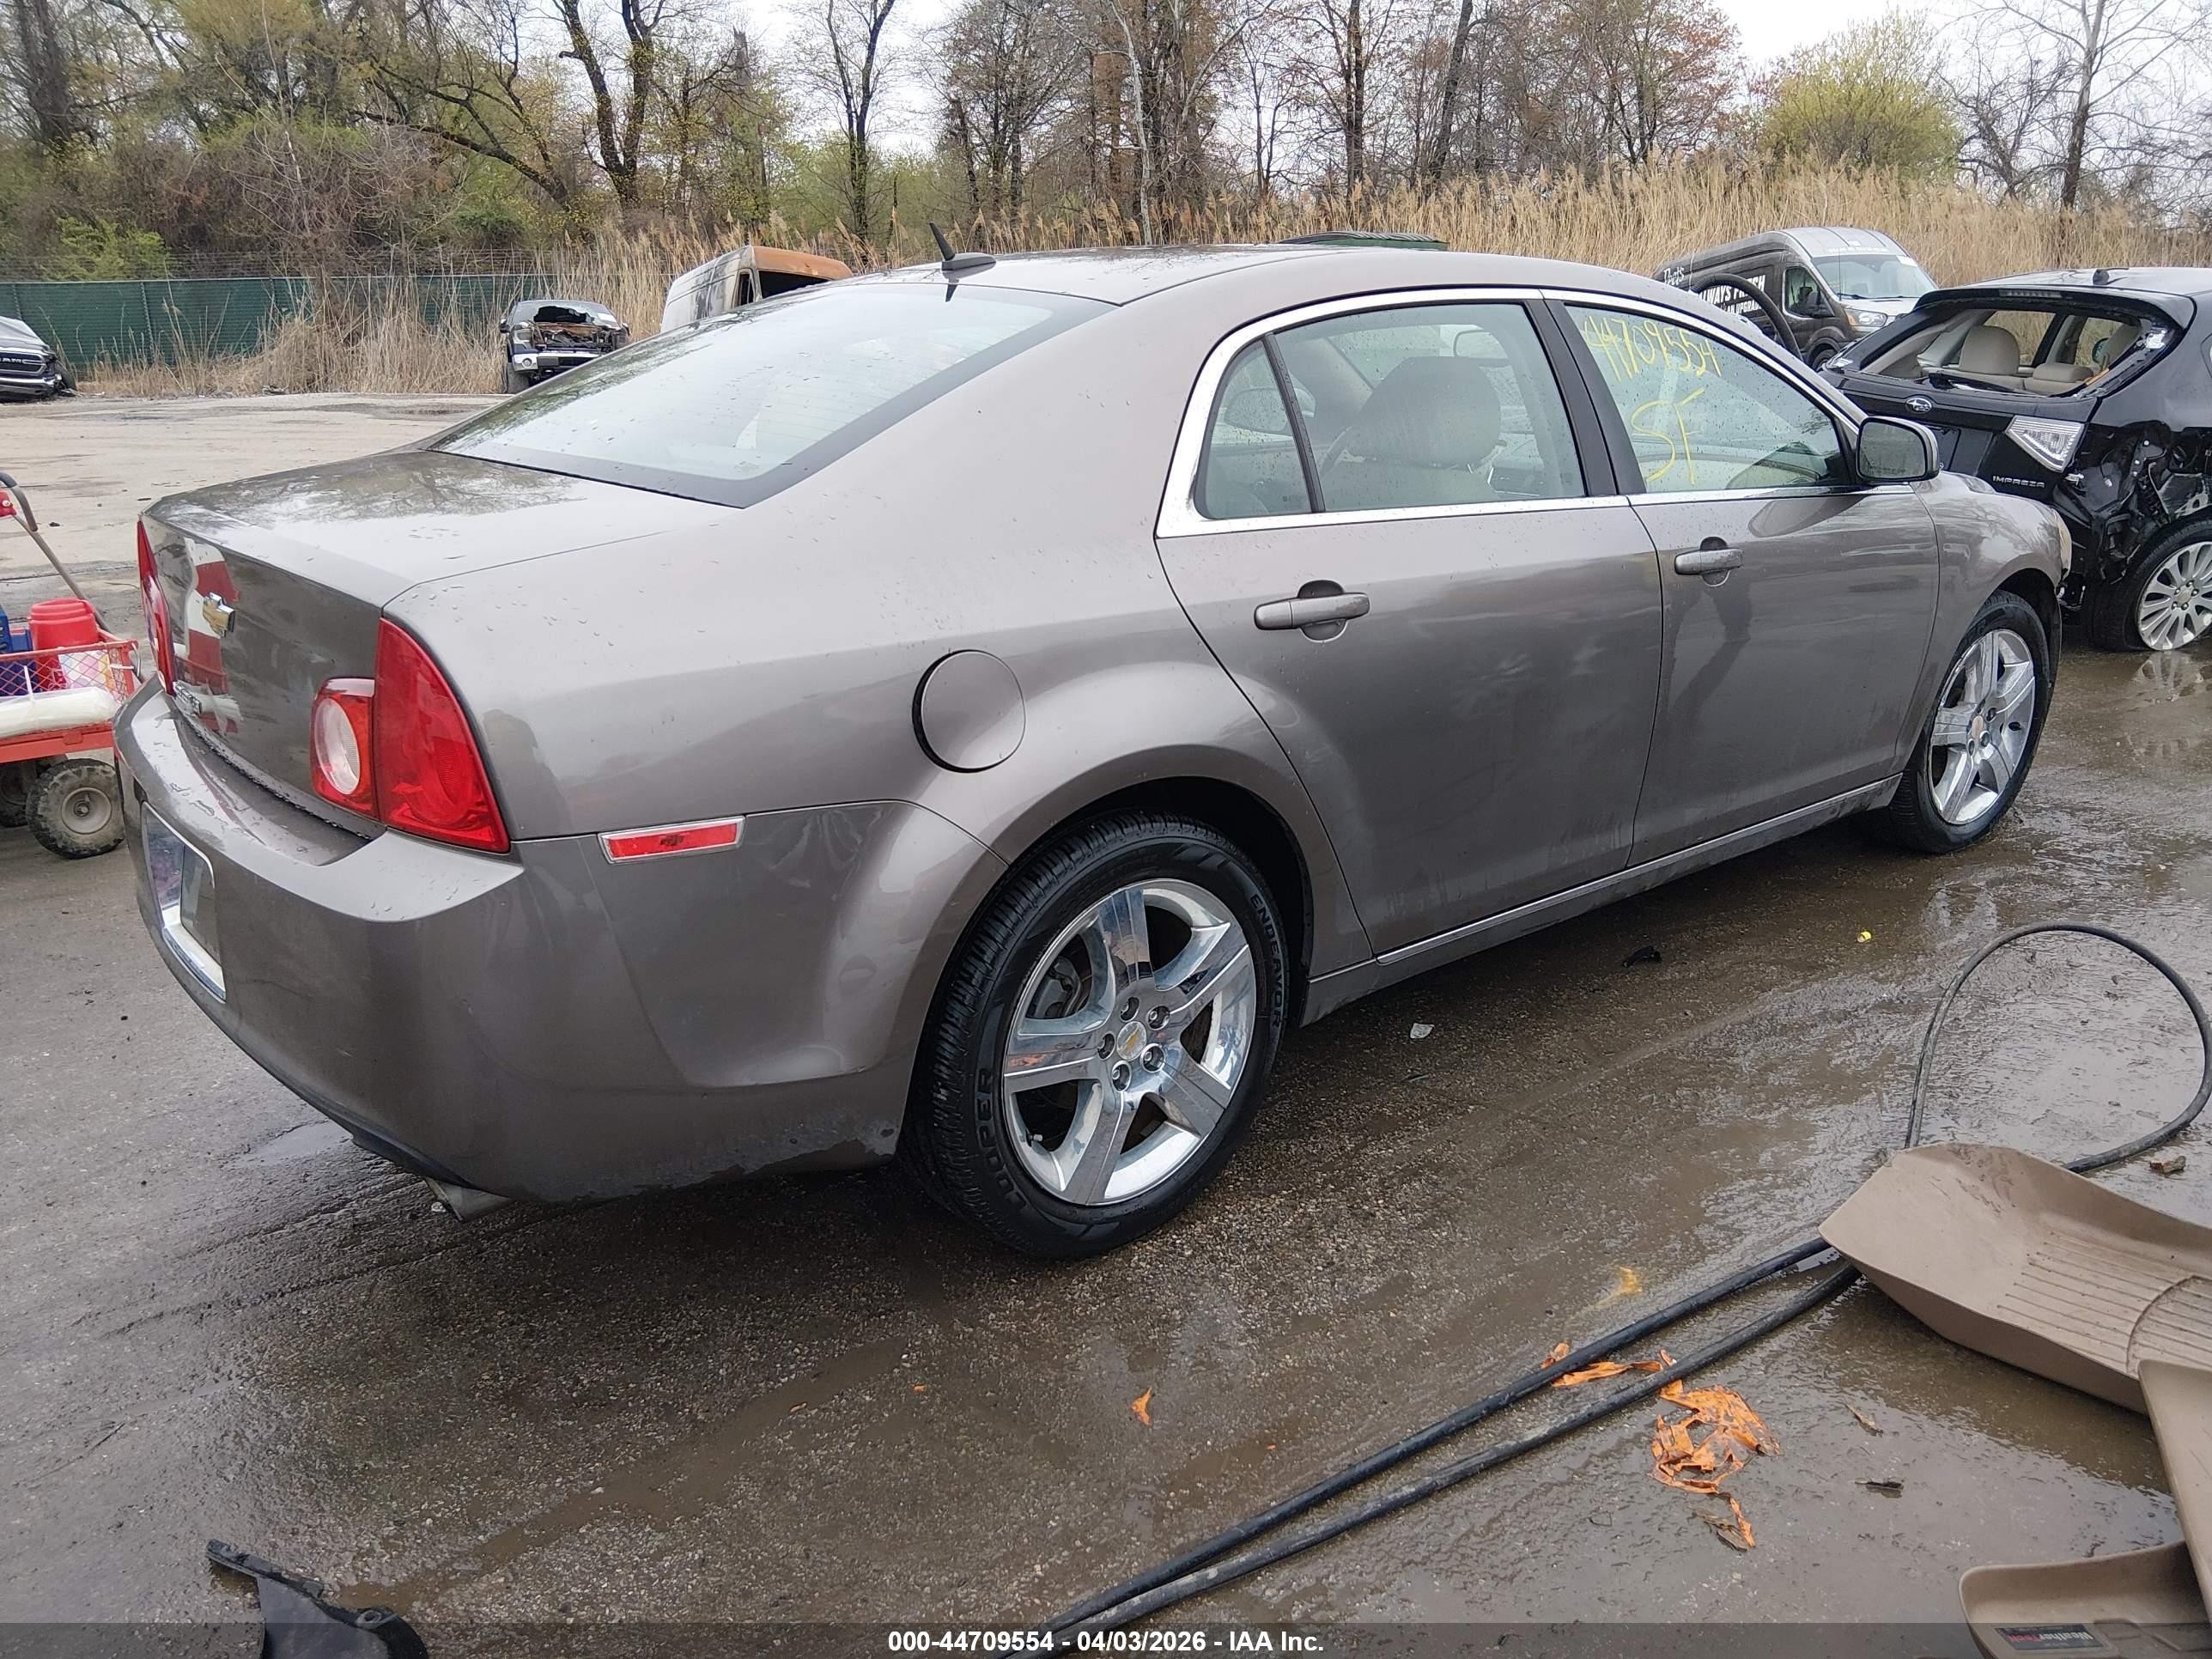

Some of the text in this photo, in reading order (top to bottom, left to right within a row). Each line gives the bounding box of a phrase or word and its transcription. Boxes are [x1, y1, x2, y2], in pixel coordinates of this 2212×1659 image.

[1735, 301, 1762, 315] UPGRAD
[1583, 315, 1723, 384] 44709554
[0, 359, 21, 368] AM
[1992, 475, 2045, 489] IMPREZA
[1250, 893, 1285, 1028] ENDEAVOR
[2008, 1631, 2094, 1643] WeatherTech
